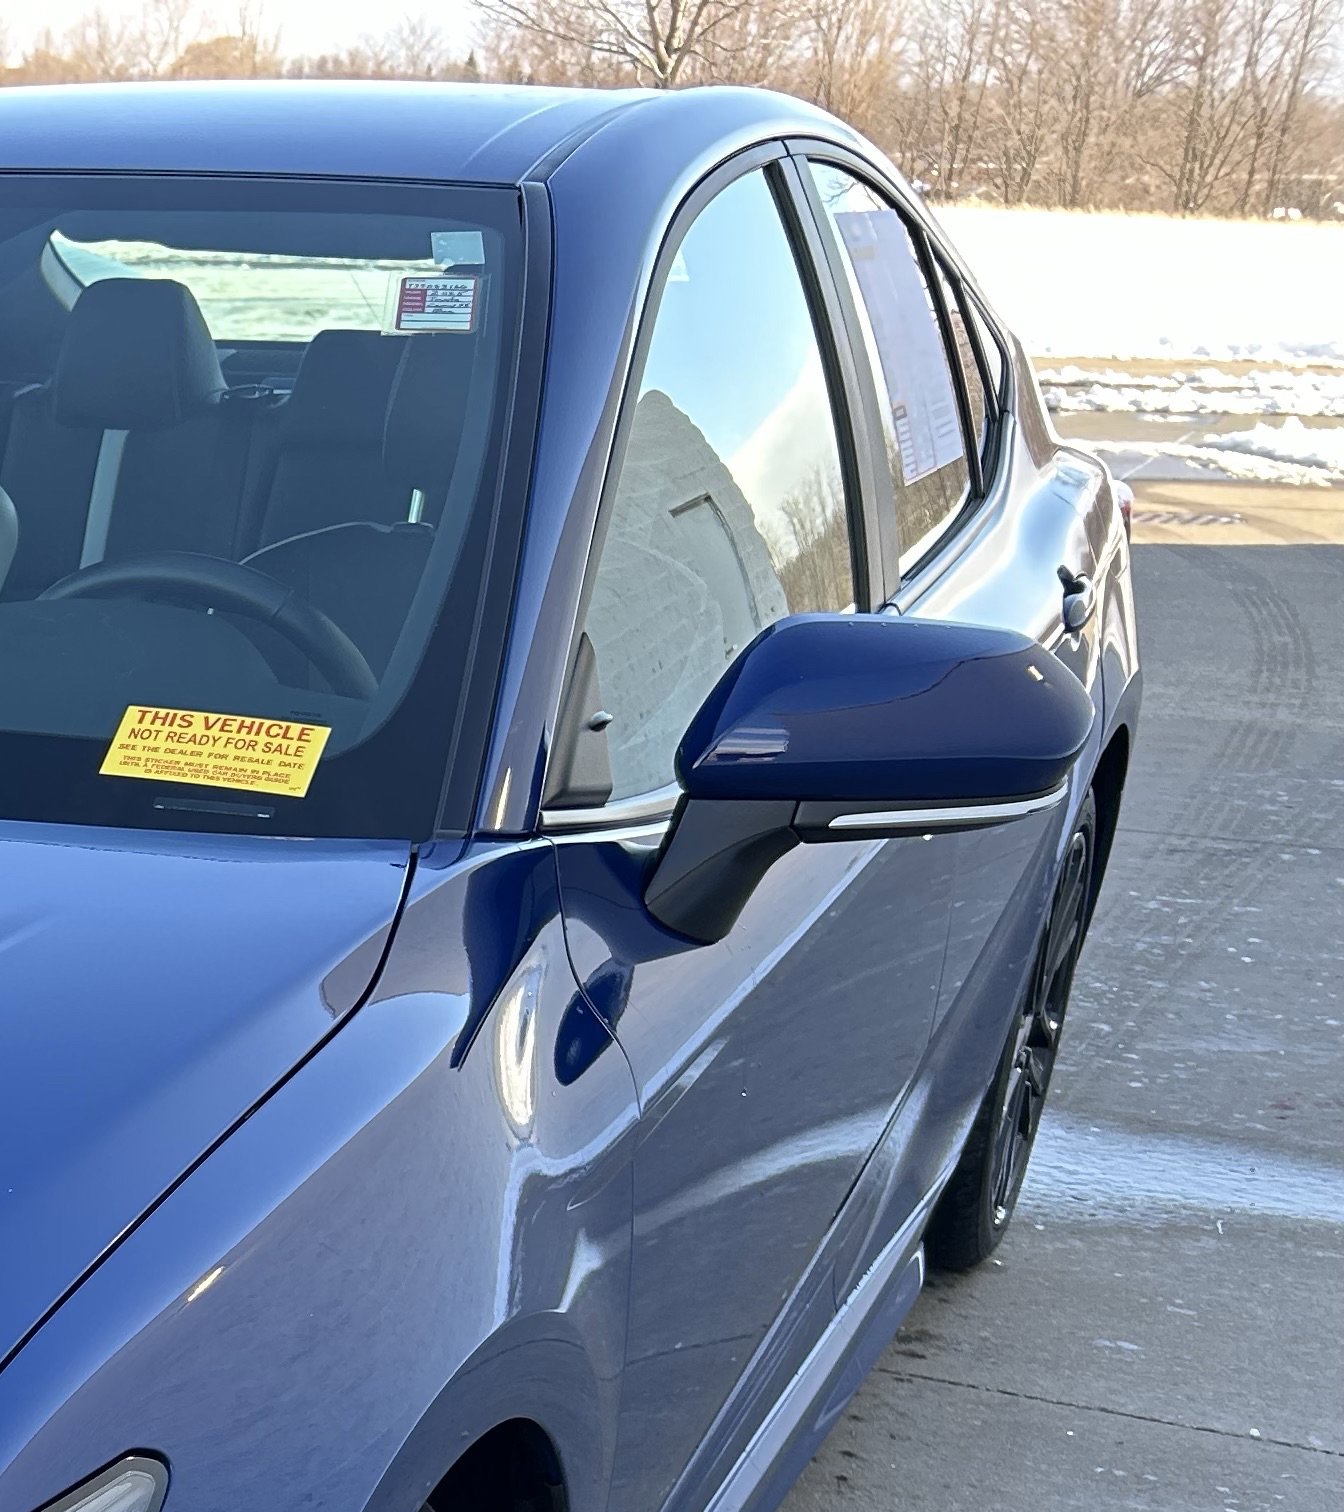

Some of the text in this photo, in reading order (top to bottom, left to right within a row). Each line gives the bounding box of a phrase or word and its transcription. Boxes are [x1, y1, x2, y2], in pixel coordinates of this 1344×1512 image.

[137, 709, 315, 743] THIS VEHICLE
[118, 743, 305, 770] SEE THE DEALER FOR RESALE DATE
[127, 727, 306, 758] NOT READY FOR SALE
